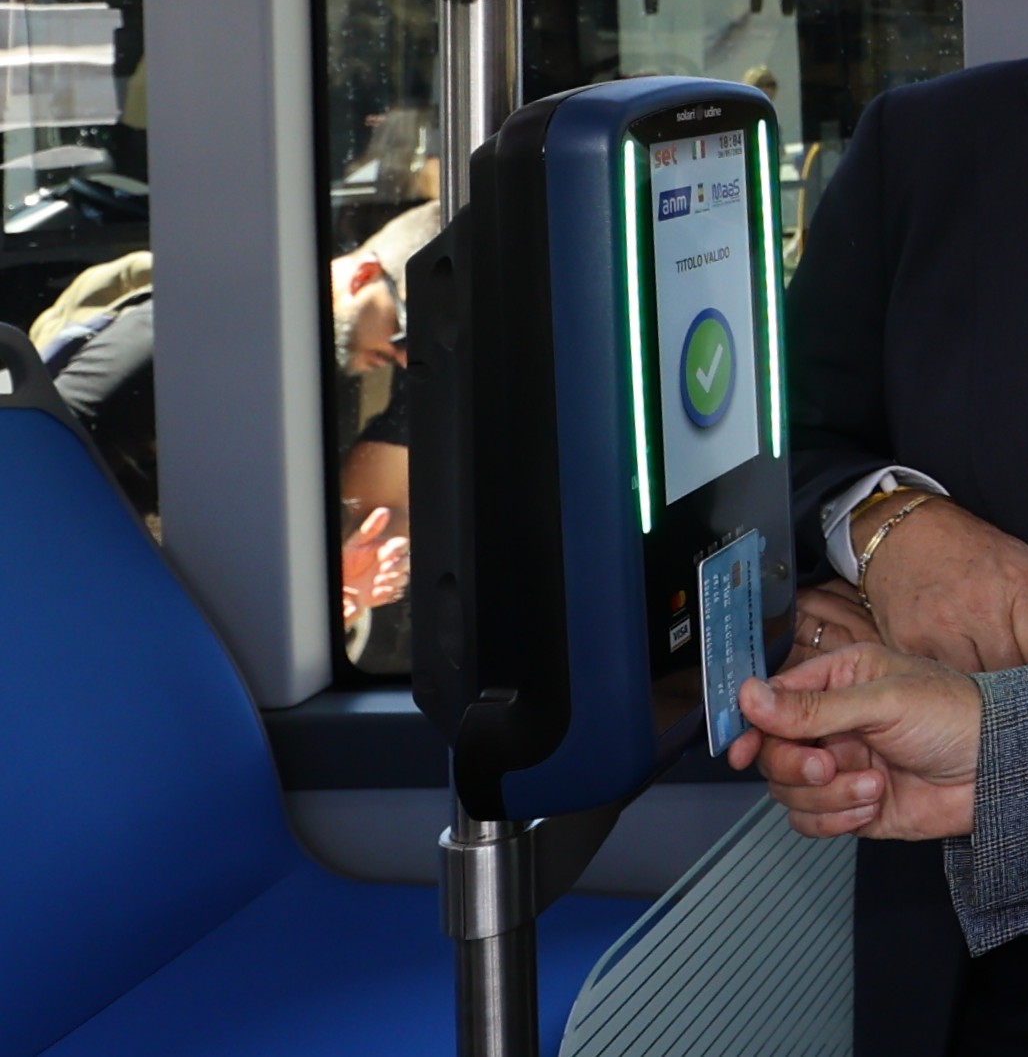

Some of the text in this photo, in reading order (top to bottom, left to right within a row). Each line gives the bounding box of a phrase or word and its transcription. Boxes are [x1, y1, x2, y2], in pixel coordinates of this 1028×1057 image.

[676, 106, 722, 122] solari udine
[654, 143, 678, 169] set
[662, 194, 687, 216] anm
[675, 246, 730, 274] TITOLO VALIDO
[672, 624, 689, 642] VISA
